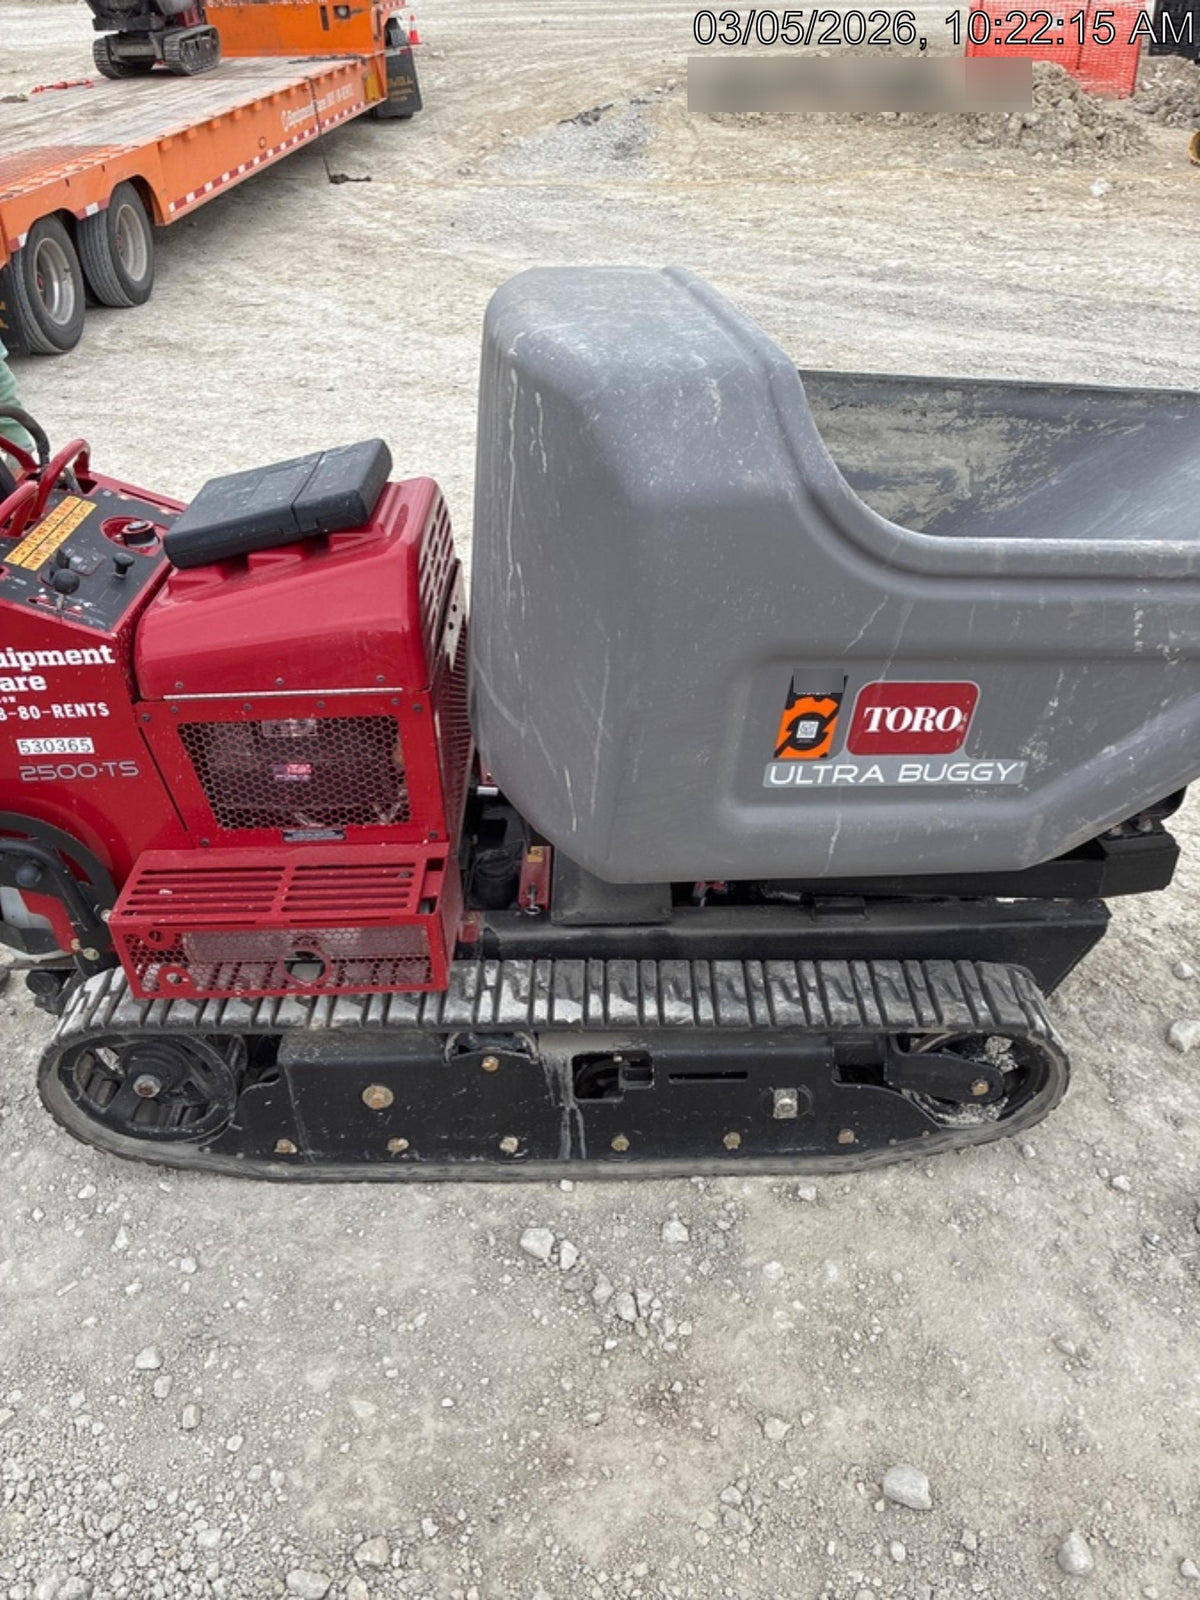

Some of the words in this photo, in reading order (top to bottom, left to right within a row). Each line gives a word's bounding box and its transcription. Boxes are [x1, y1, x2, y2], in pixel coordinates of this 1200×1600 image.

[864, 705, 963, 733] TORO
[20, 739, 91, 754] 530365
[769, 763, 885, 785] ULTRA
[897, 762, 1018, 783] BUGGY
